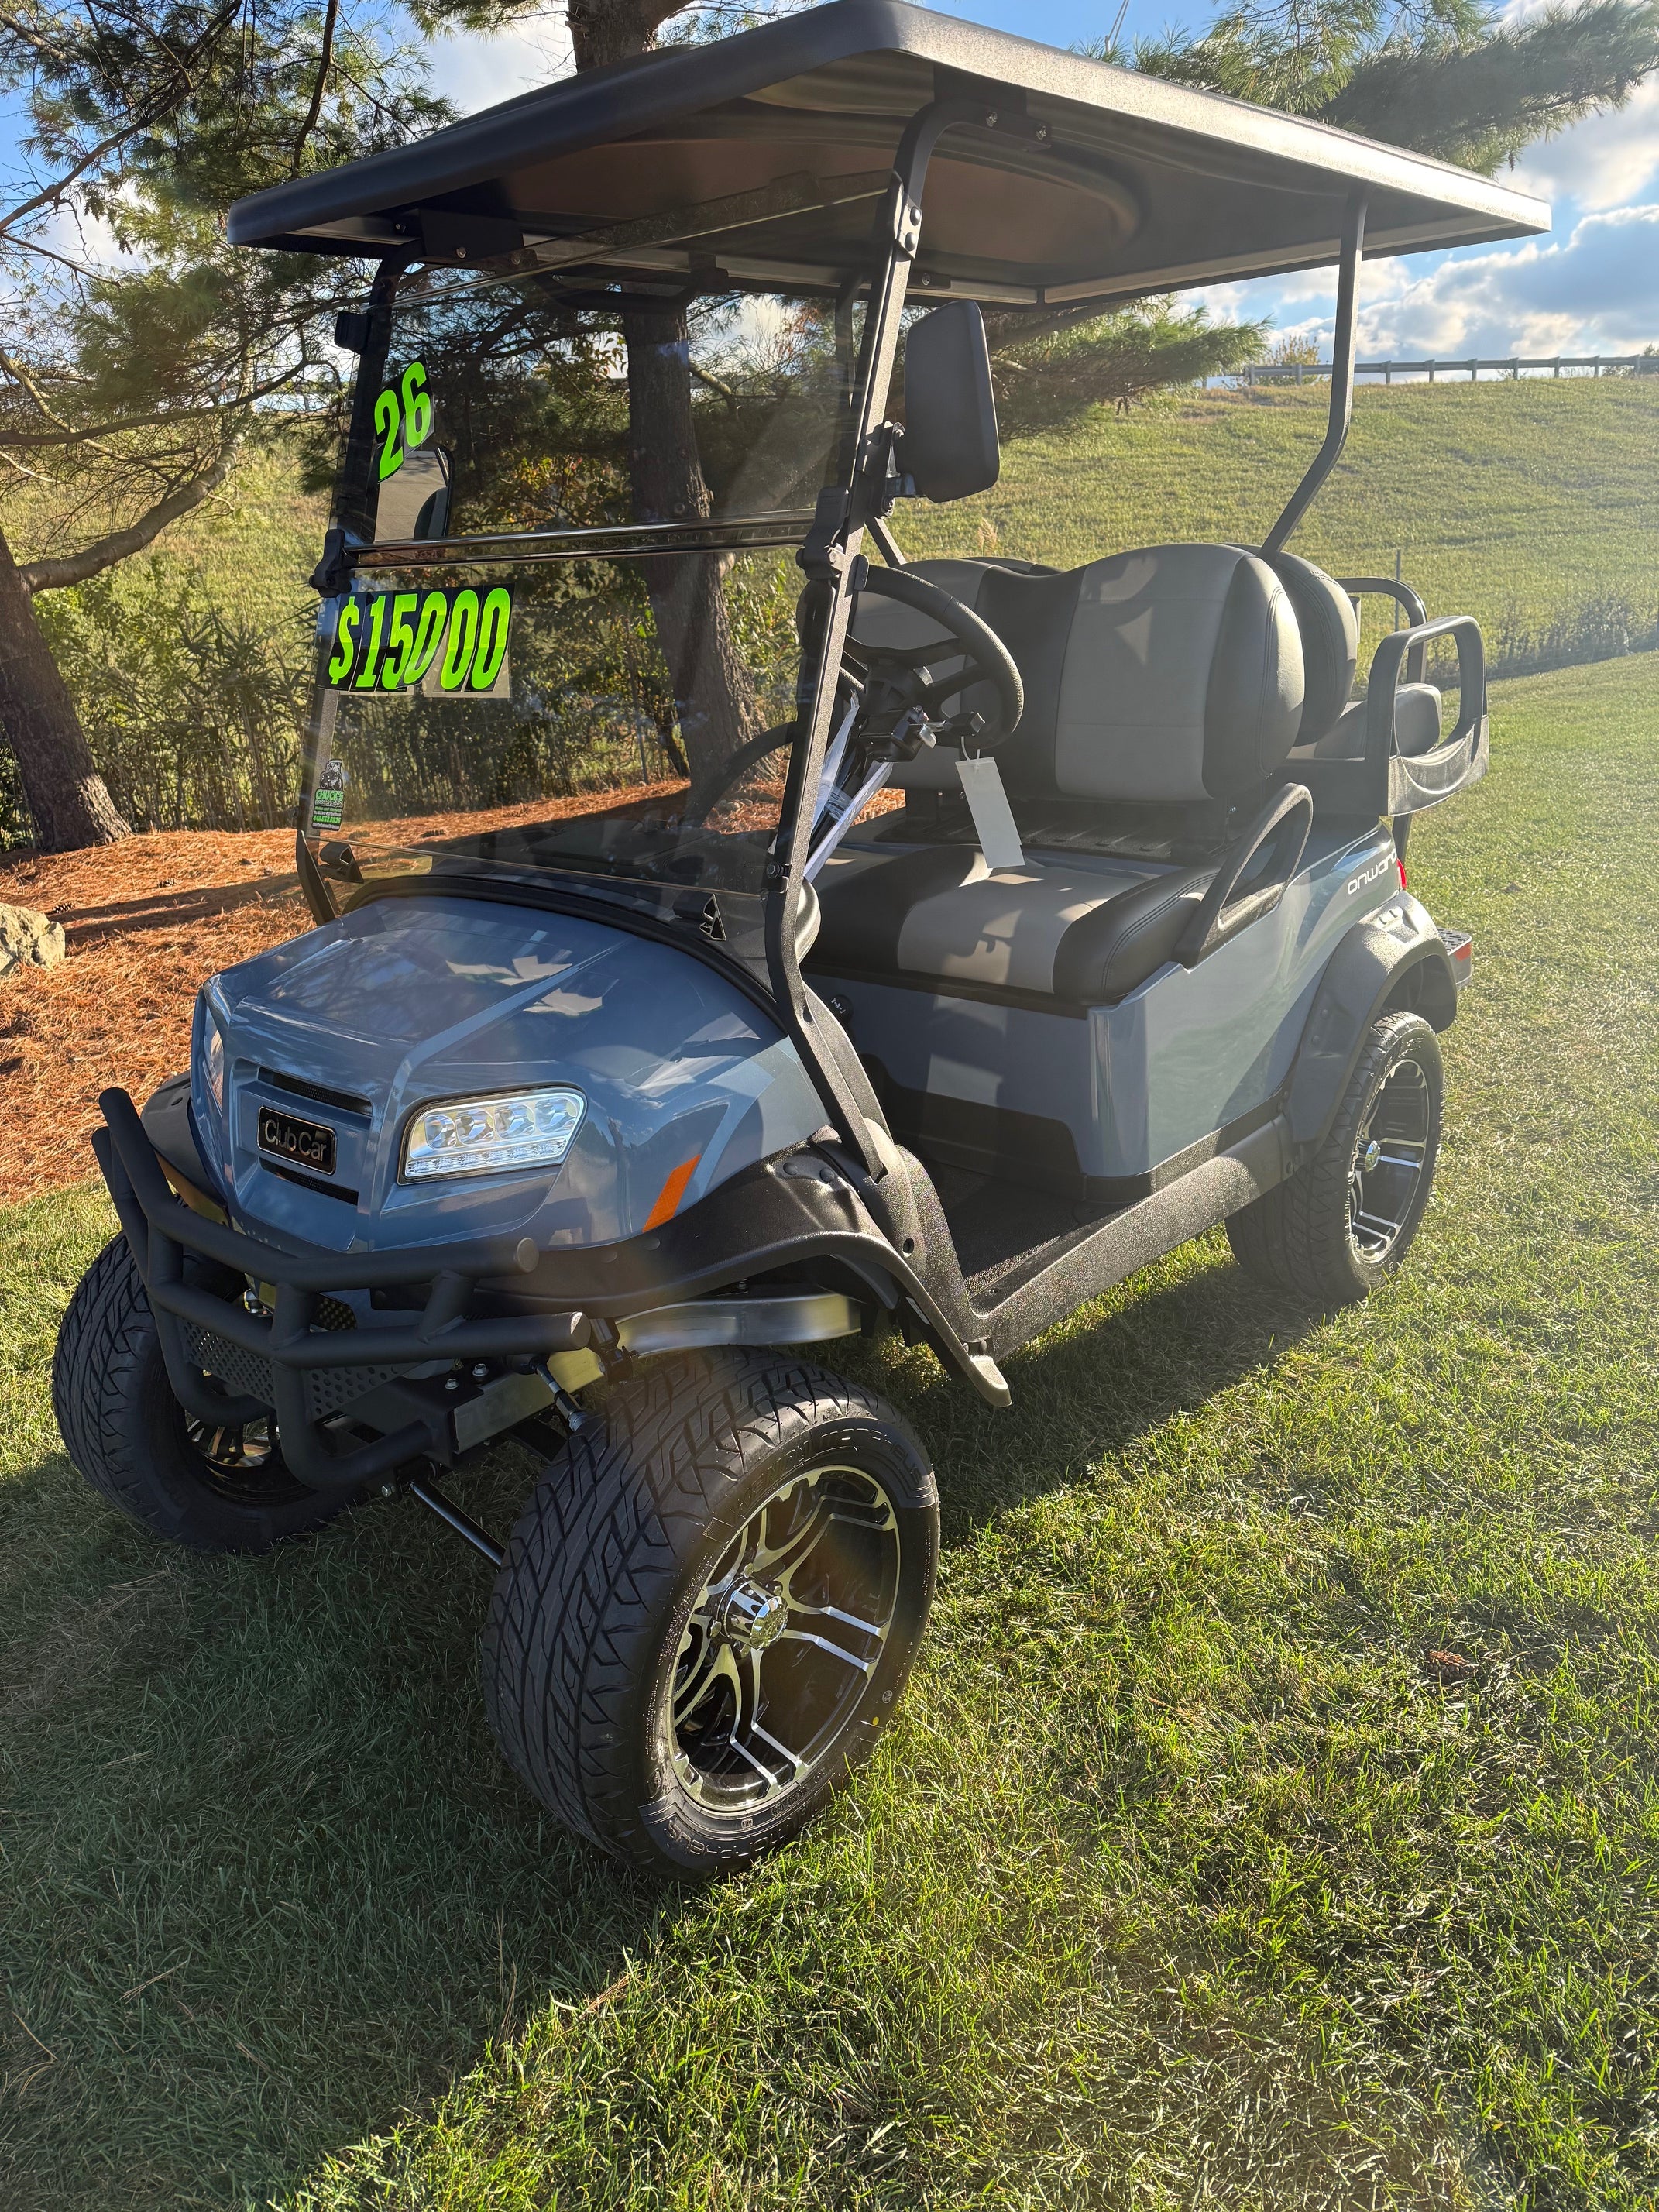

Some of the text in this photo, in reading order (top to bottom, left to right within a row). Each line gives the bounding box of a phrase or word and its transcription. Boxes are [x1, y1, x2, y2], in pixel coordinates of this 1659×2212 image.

[374, 361, 431, 482] 26
[328, 587, 511, 691] $15000
[264, 1117, 327, 1162] Club Car
